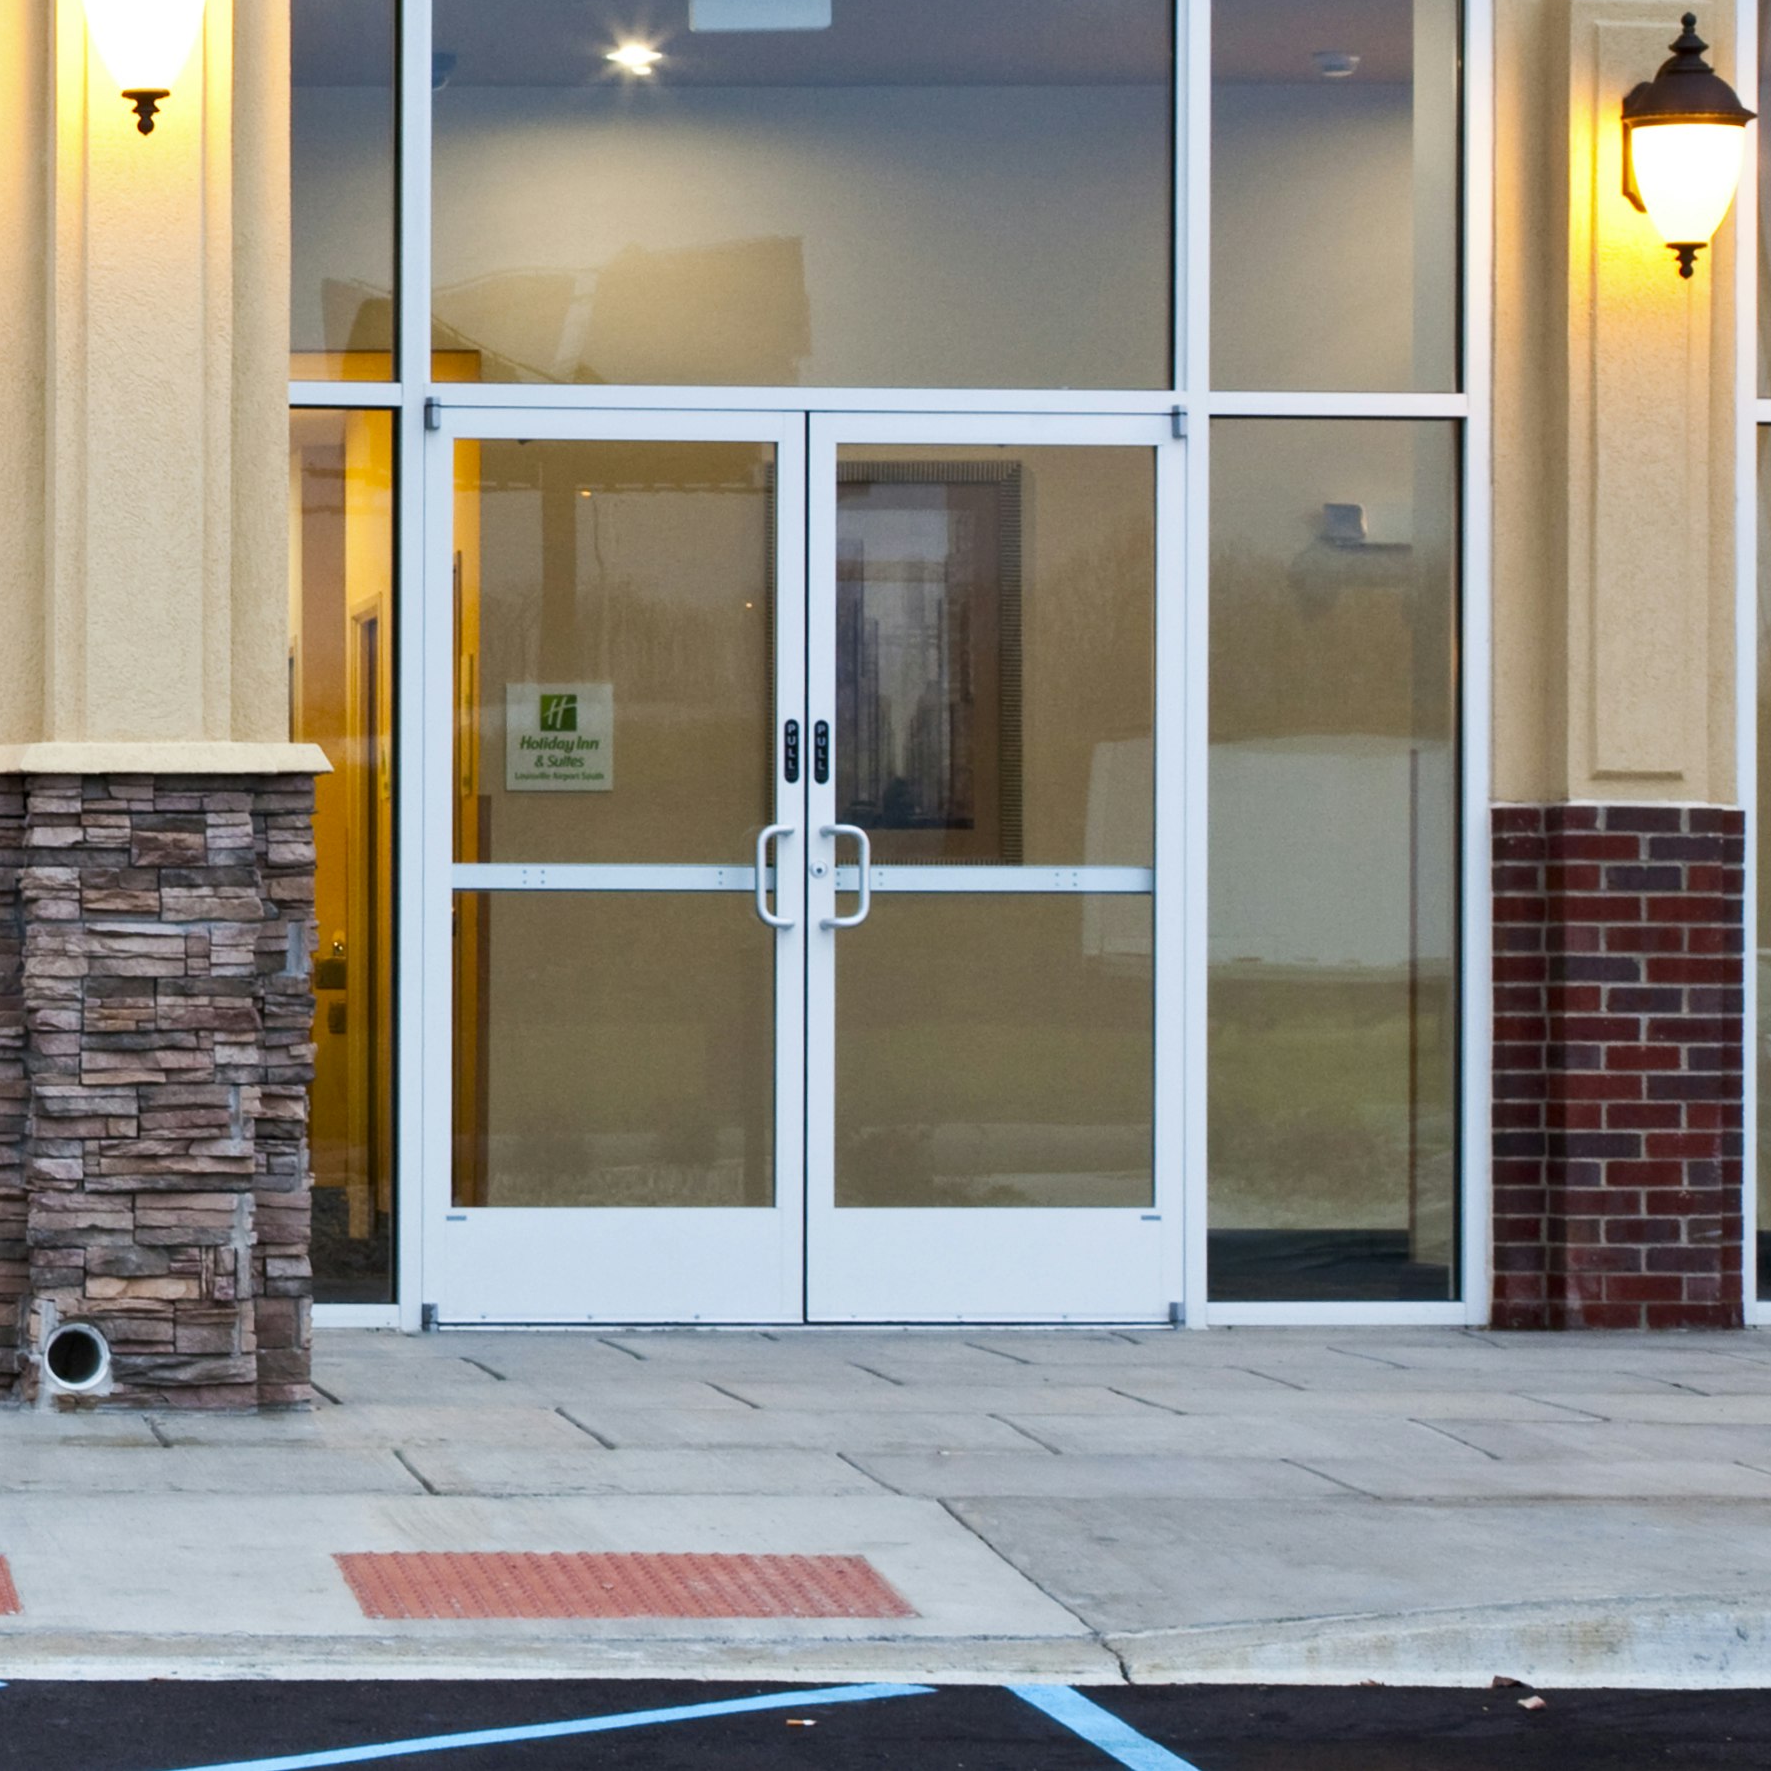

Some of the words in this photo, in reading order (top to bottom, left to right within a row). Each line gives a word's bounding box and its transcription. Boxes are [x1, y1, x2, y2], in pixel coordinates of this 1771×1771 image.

[520, 735, 575, 754] Holiday
[577, 735, 599, 750] Inn
[534, 754, 544, 768] &
[547, 754, 585, 768] Suites
[787, 723, 796, 770] PULL
[817, 724, 826, 771] PULL
